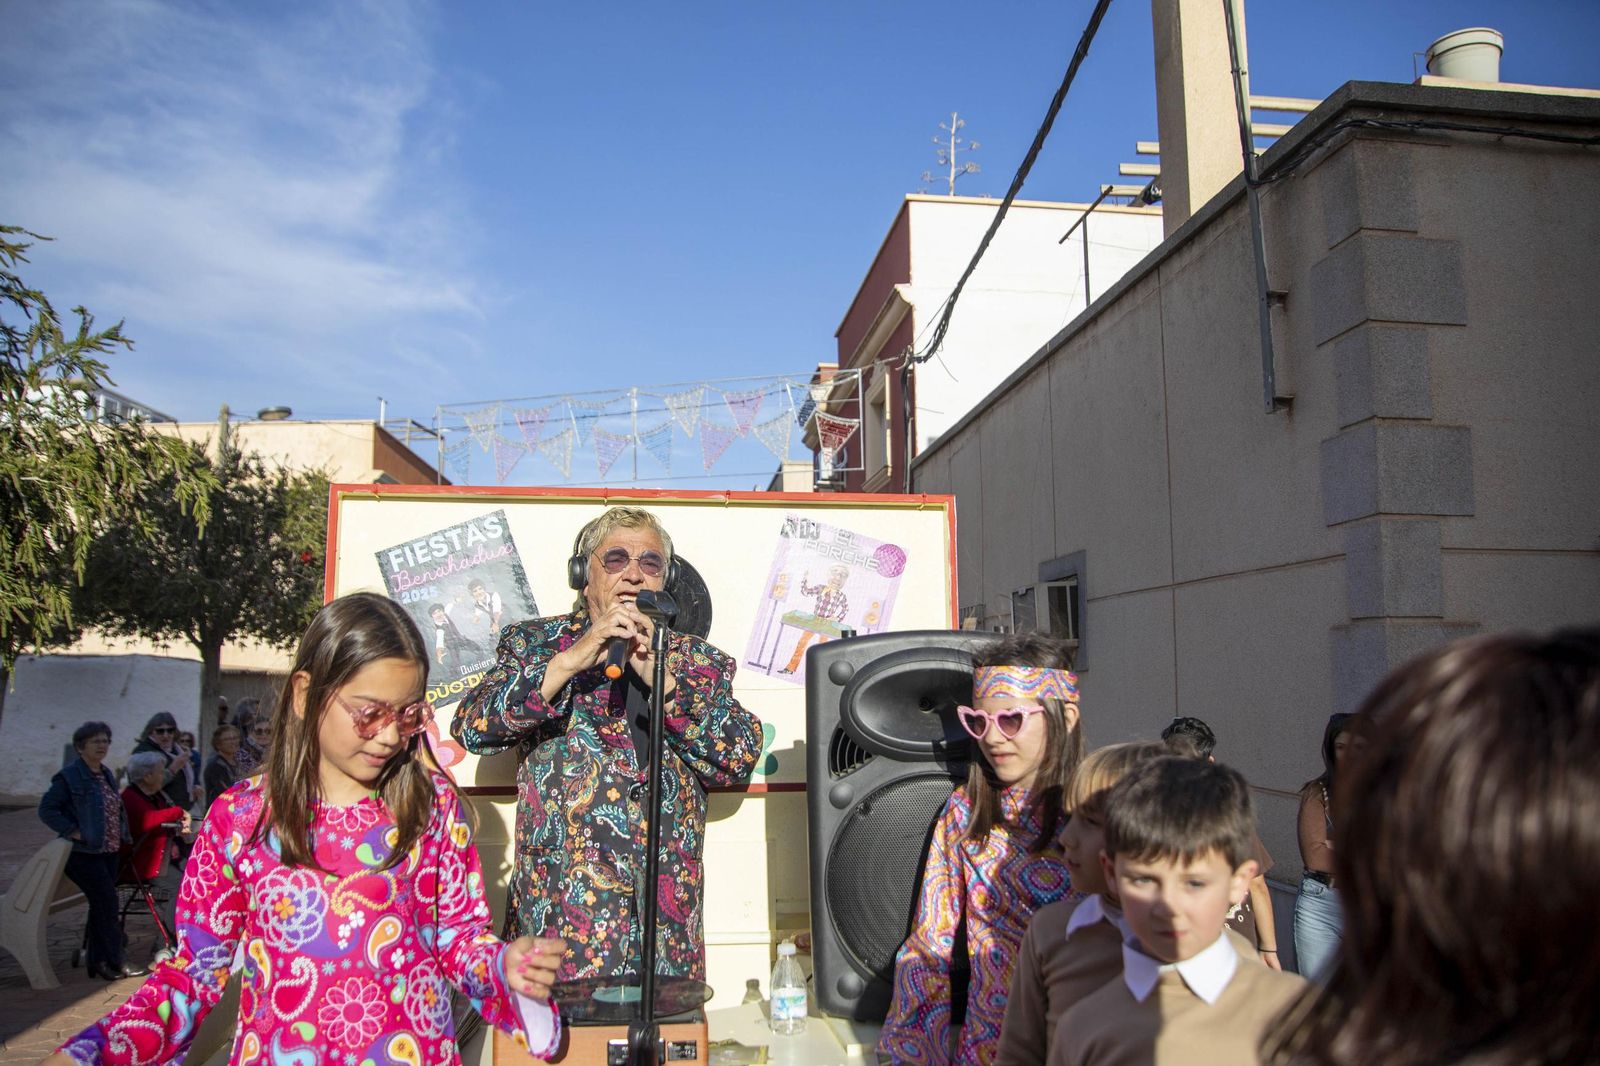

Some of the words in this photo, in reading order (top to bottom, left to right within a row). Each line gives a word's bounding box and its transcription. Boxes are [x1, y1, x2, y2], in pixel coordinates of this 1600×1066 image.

[388, 516, 503, 573] FIESTAS
[391, 542, 514, 593] Benahadux
[401, 586, 438, 605] 2025
[460, 657, 497, 675] Quisiera
[425, 681, 465, 703] DÚO
